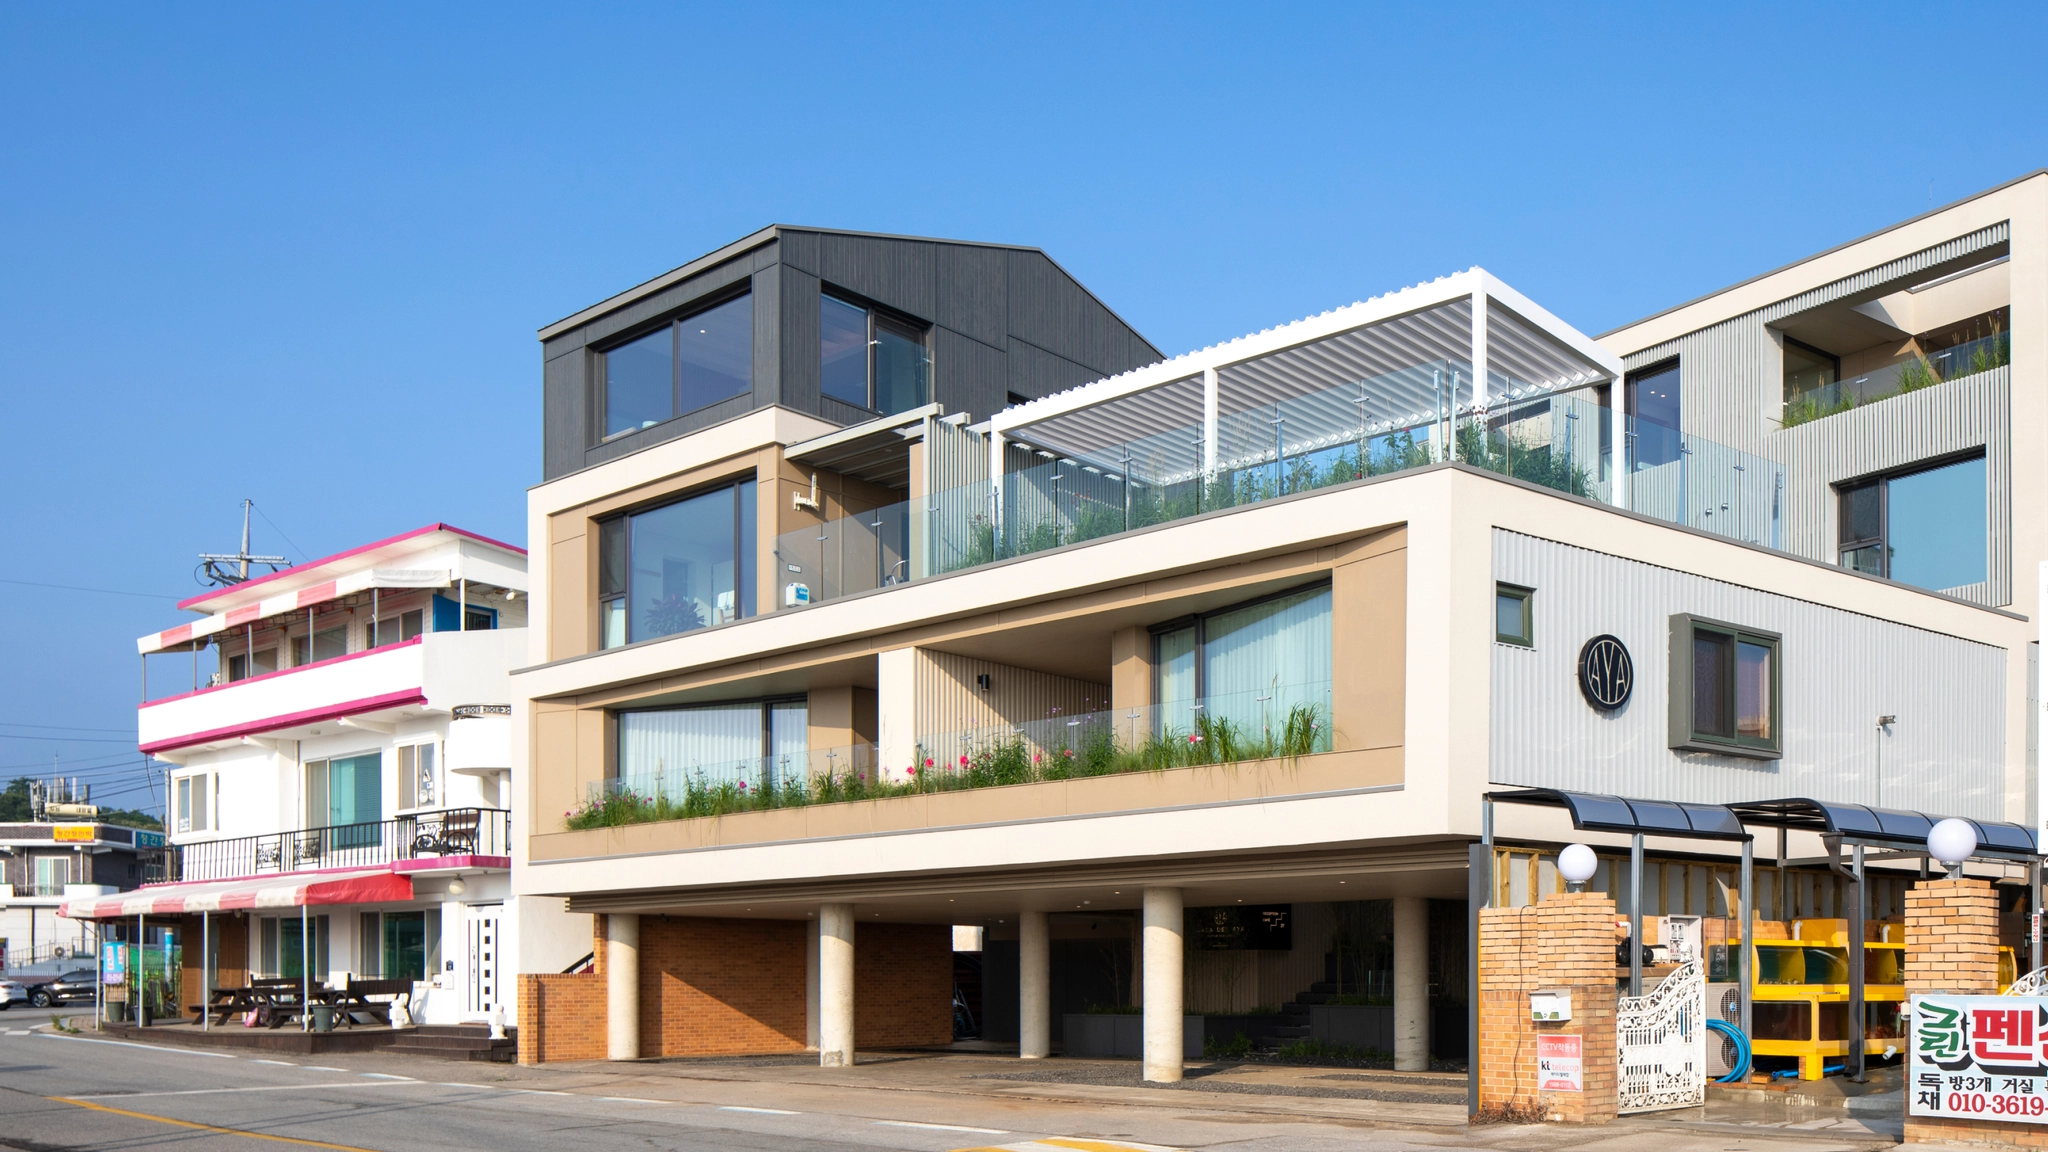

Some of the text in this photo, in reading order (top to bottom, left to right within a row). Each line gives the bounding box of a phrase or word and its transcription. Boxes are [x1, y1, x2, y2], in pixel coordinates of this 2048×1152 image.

[1590, 641, 1628, 702] AYA
[1541, 1043, 1577, 1053] CCTV작동중
[1541, 1060, 1579, 1073] kt telecop
[1948, 1075, 1992, 1092] 방3개
[2001, 1078, 2034, 1094] 거실
